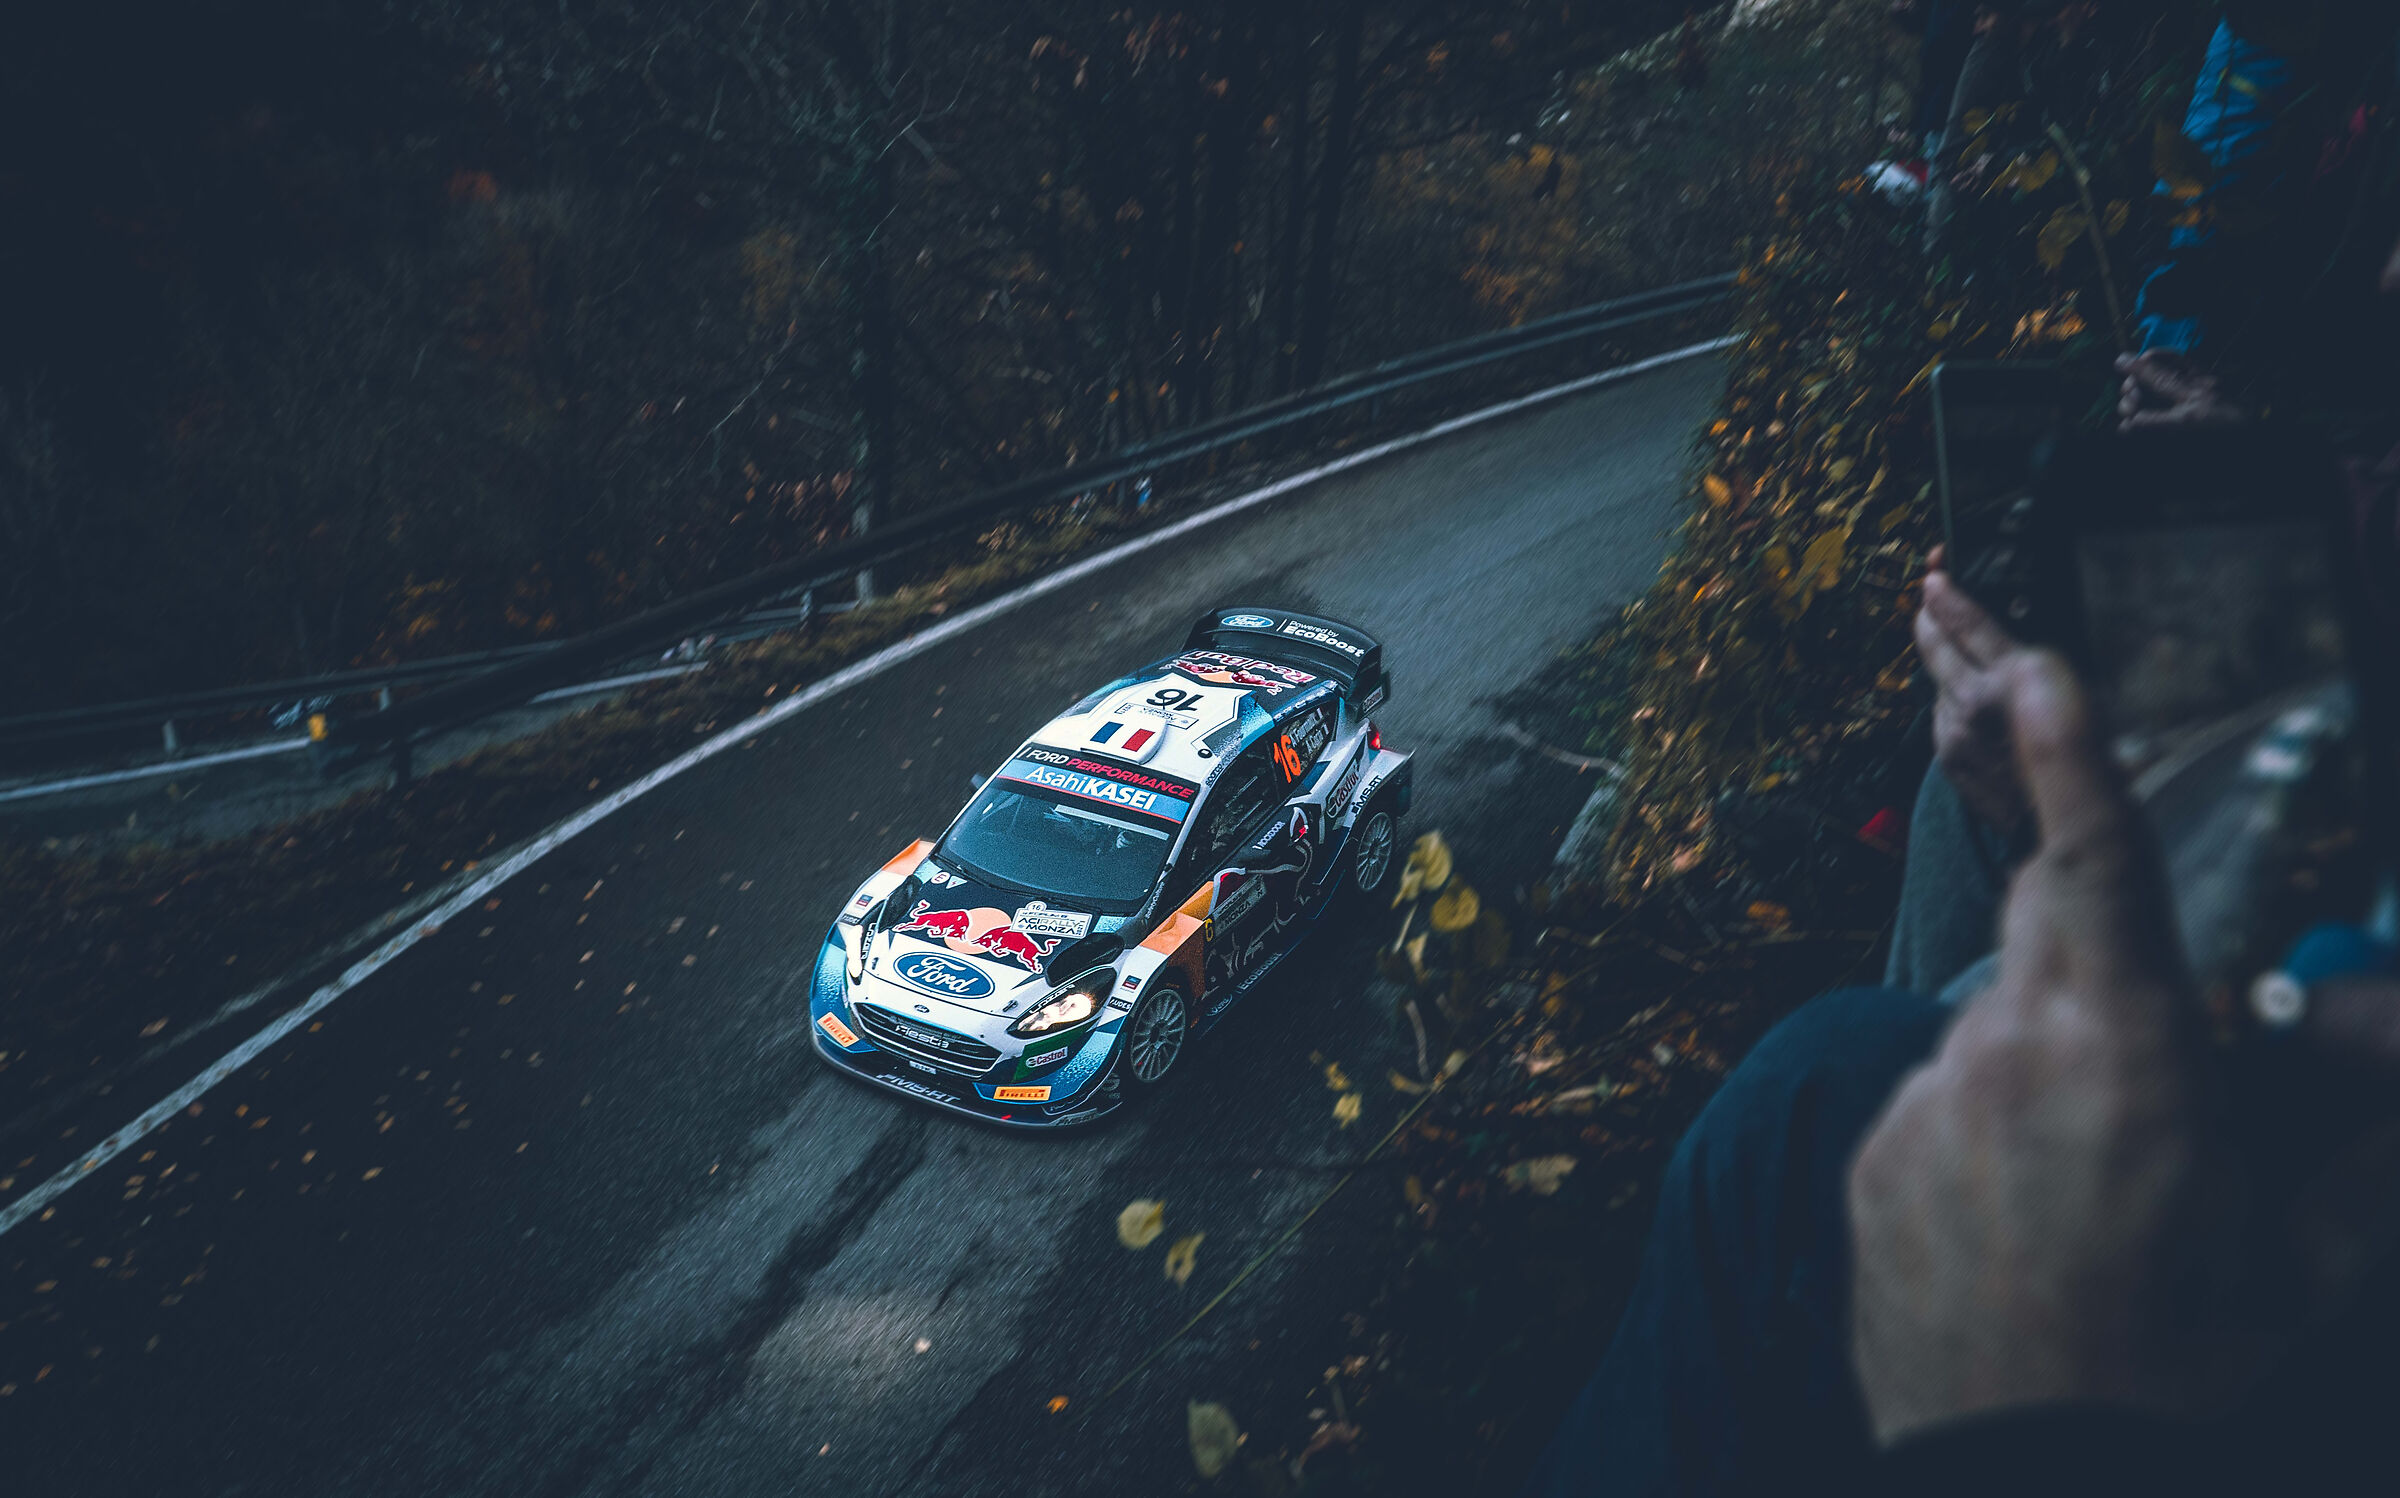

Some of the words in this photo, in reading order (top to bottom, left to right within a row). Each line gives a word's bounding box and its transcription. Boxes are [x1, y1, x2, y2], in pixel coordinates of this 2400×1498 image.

[1289, 620, 1325, 634] Powered
[1326, 629, 1339, 638] by
[1283, 626, 1365, 658] EcoBoost
[1146, 689, 1204, 711] 16
[1273, 734, 1301, 784] 16
[1026, 749, 1069, 764] FORD
[1066, 758, 1195, 799] PERFORMANCE
[1026, 924, 1075, 934] MONZA
[906, 957, 976, 993] Ford
[1036, 1049, 1066, 1065] Castrol
[999, 1089, 1046, 1098] PIRELLI
